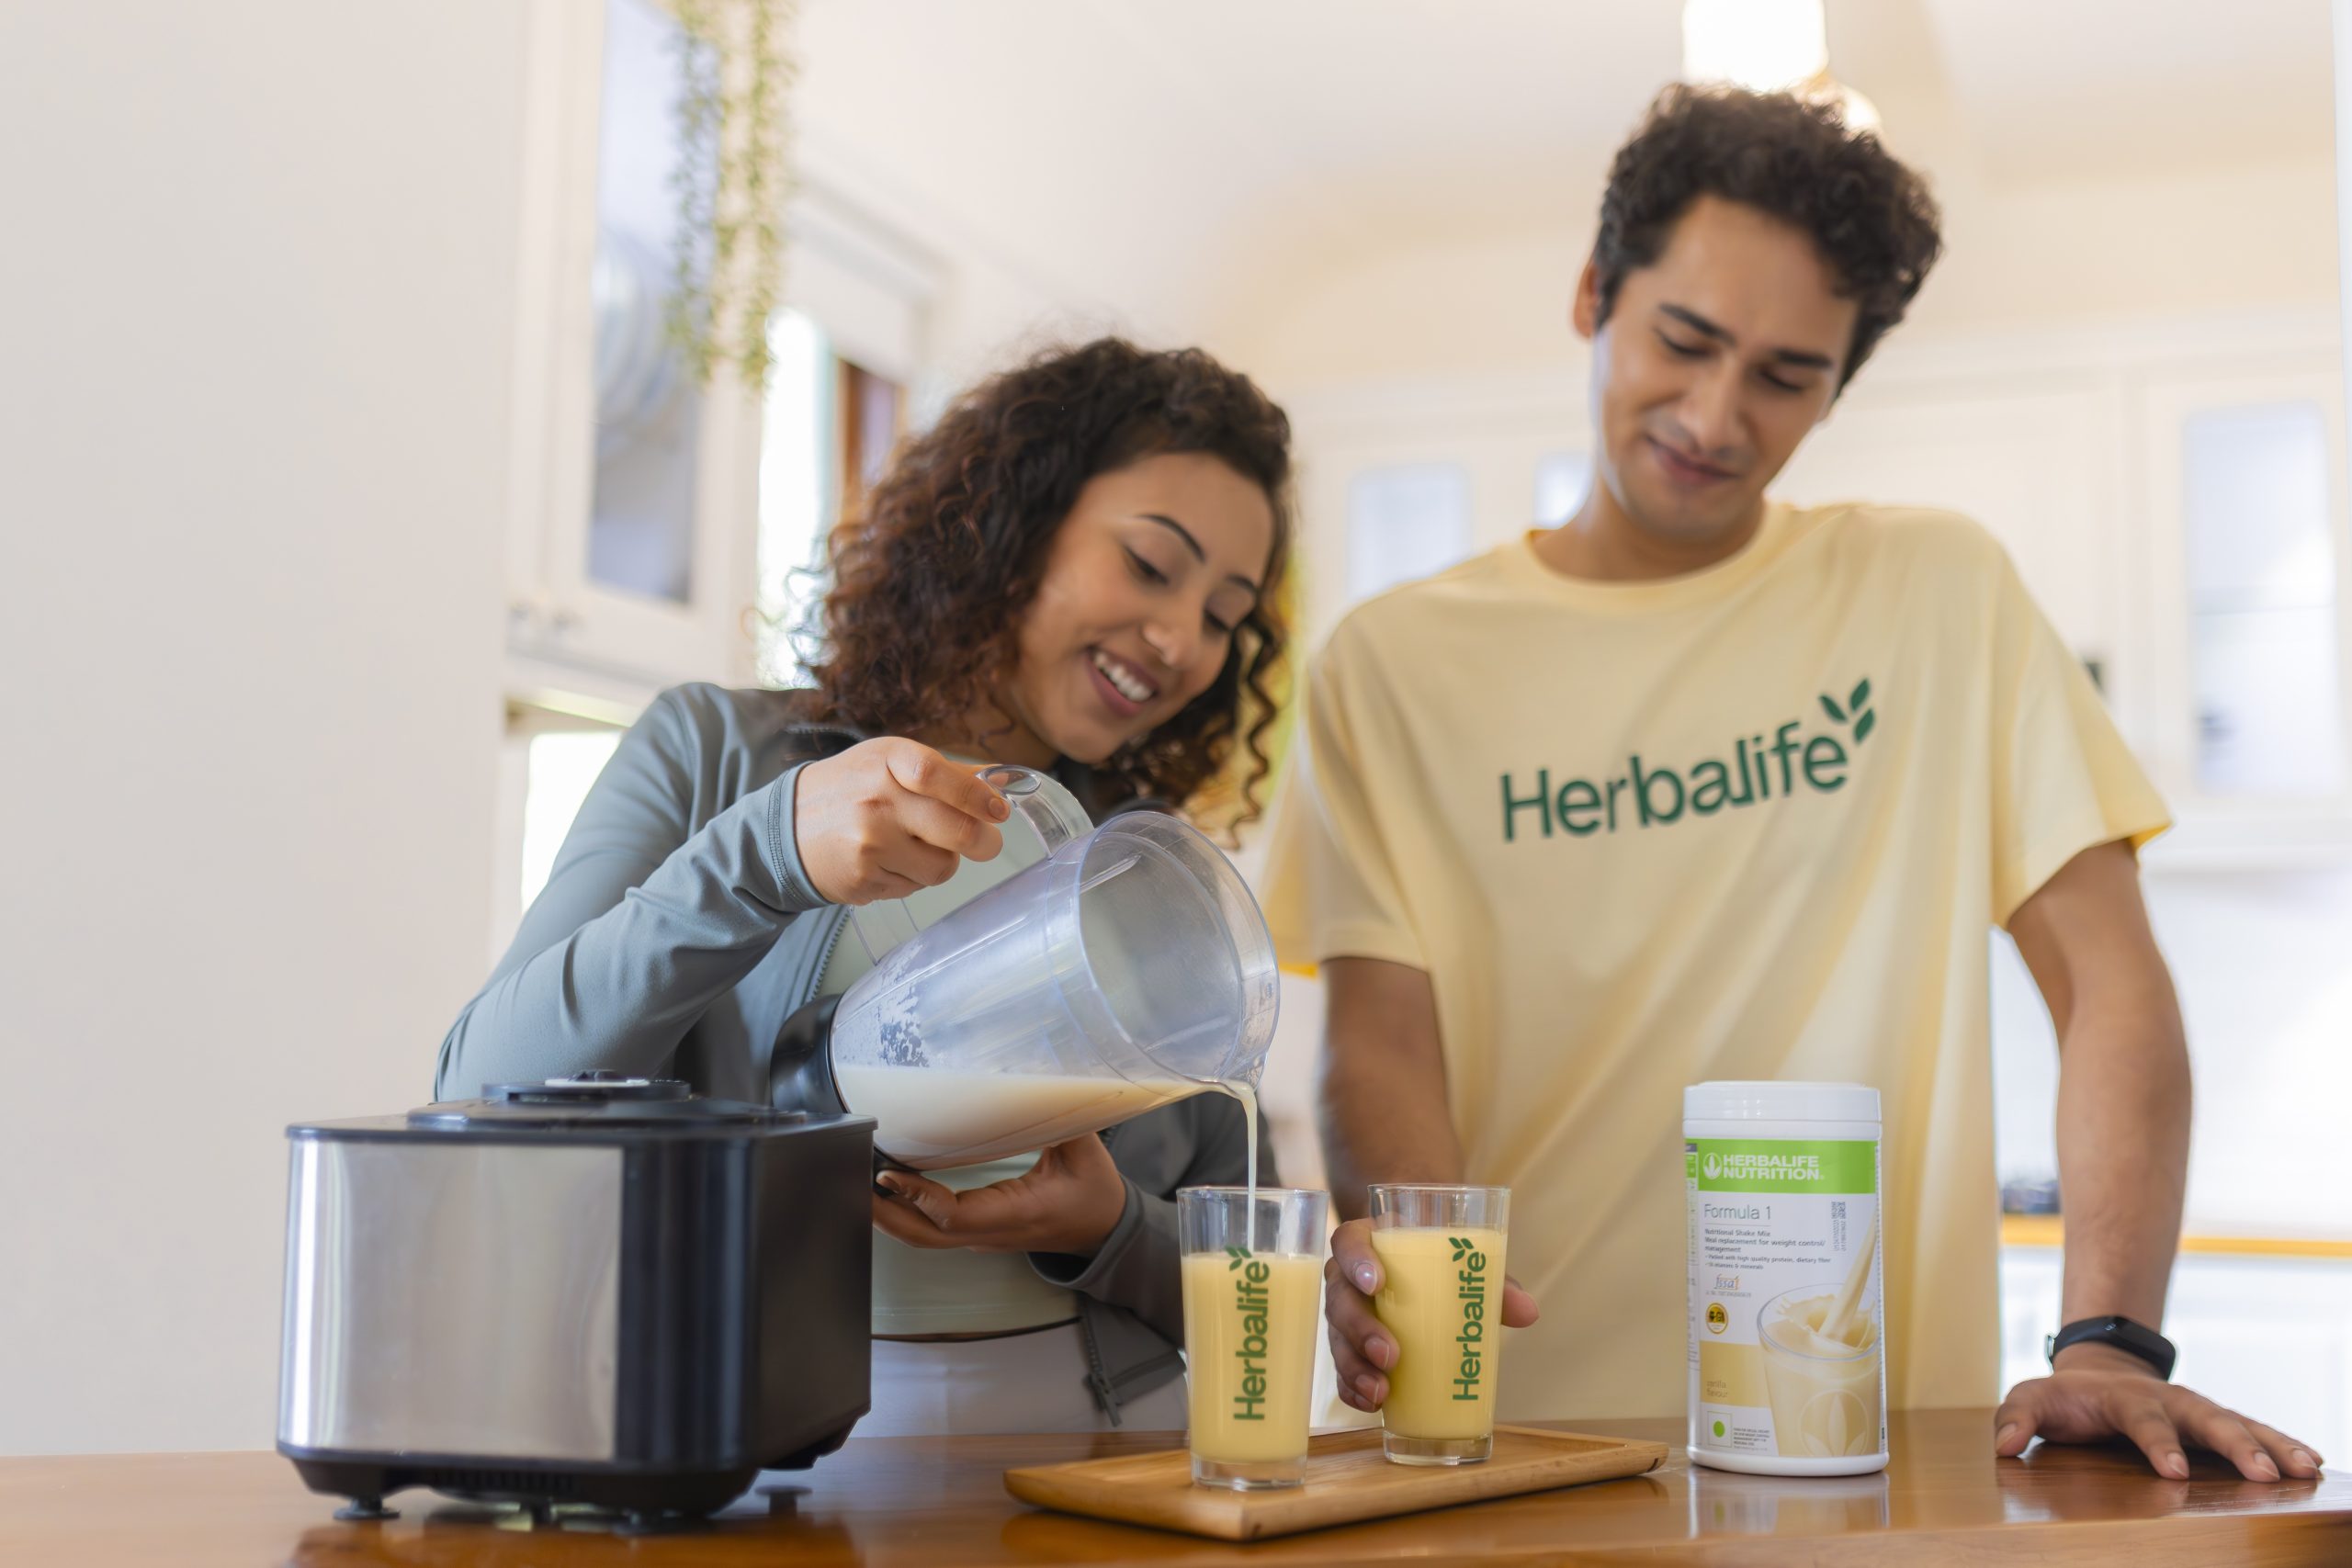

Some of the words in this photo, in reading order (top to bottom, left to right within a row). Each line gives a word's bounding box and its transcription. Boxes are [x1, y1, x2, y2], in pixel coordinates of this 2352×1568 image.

[1499, 721, 1849, 842] Herbalife
[1724, 1155, 1819, 1168] HERBALIFE
[1704, 1203, 1759, 1220] Formula
[1766, 1205, 1770, 1220] 1
[1771, 1239, 1796, 1247] weight
[1233, 1260, 1270, 1420] Herbalife
[1453, 1251, 1487, 1401] Herbalife
